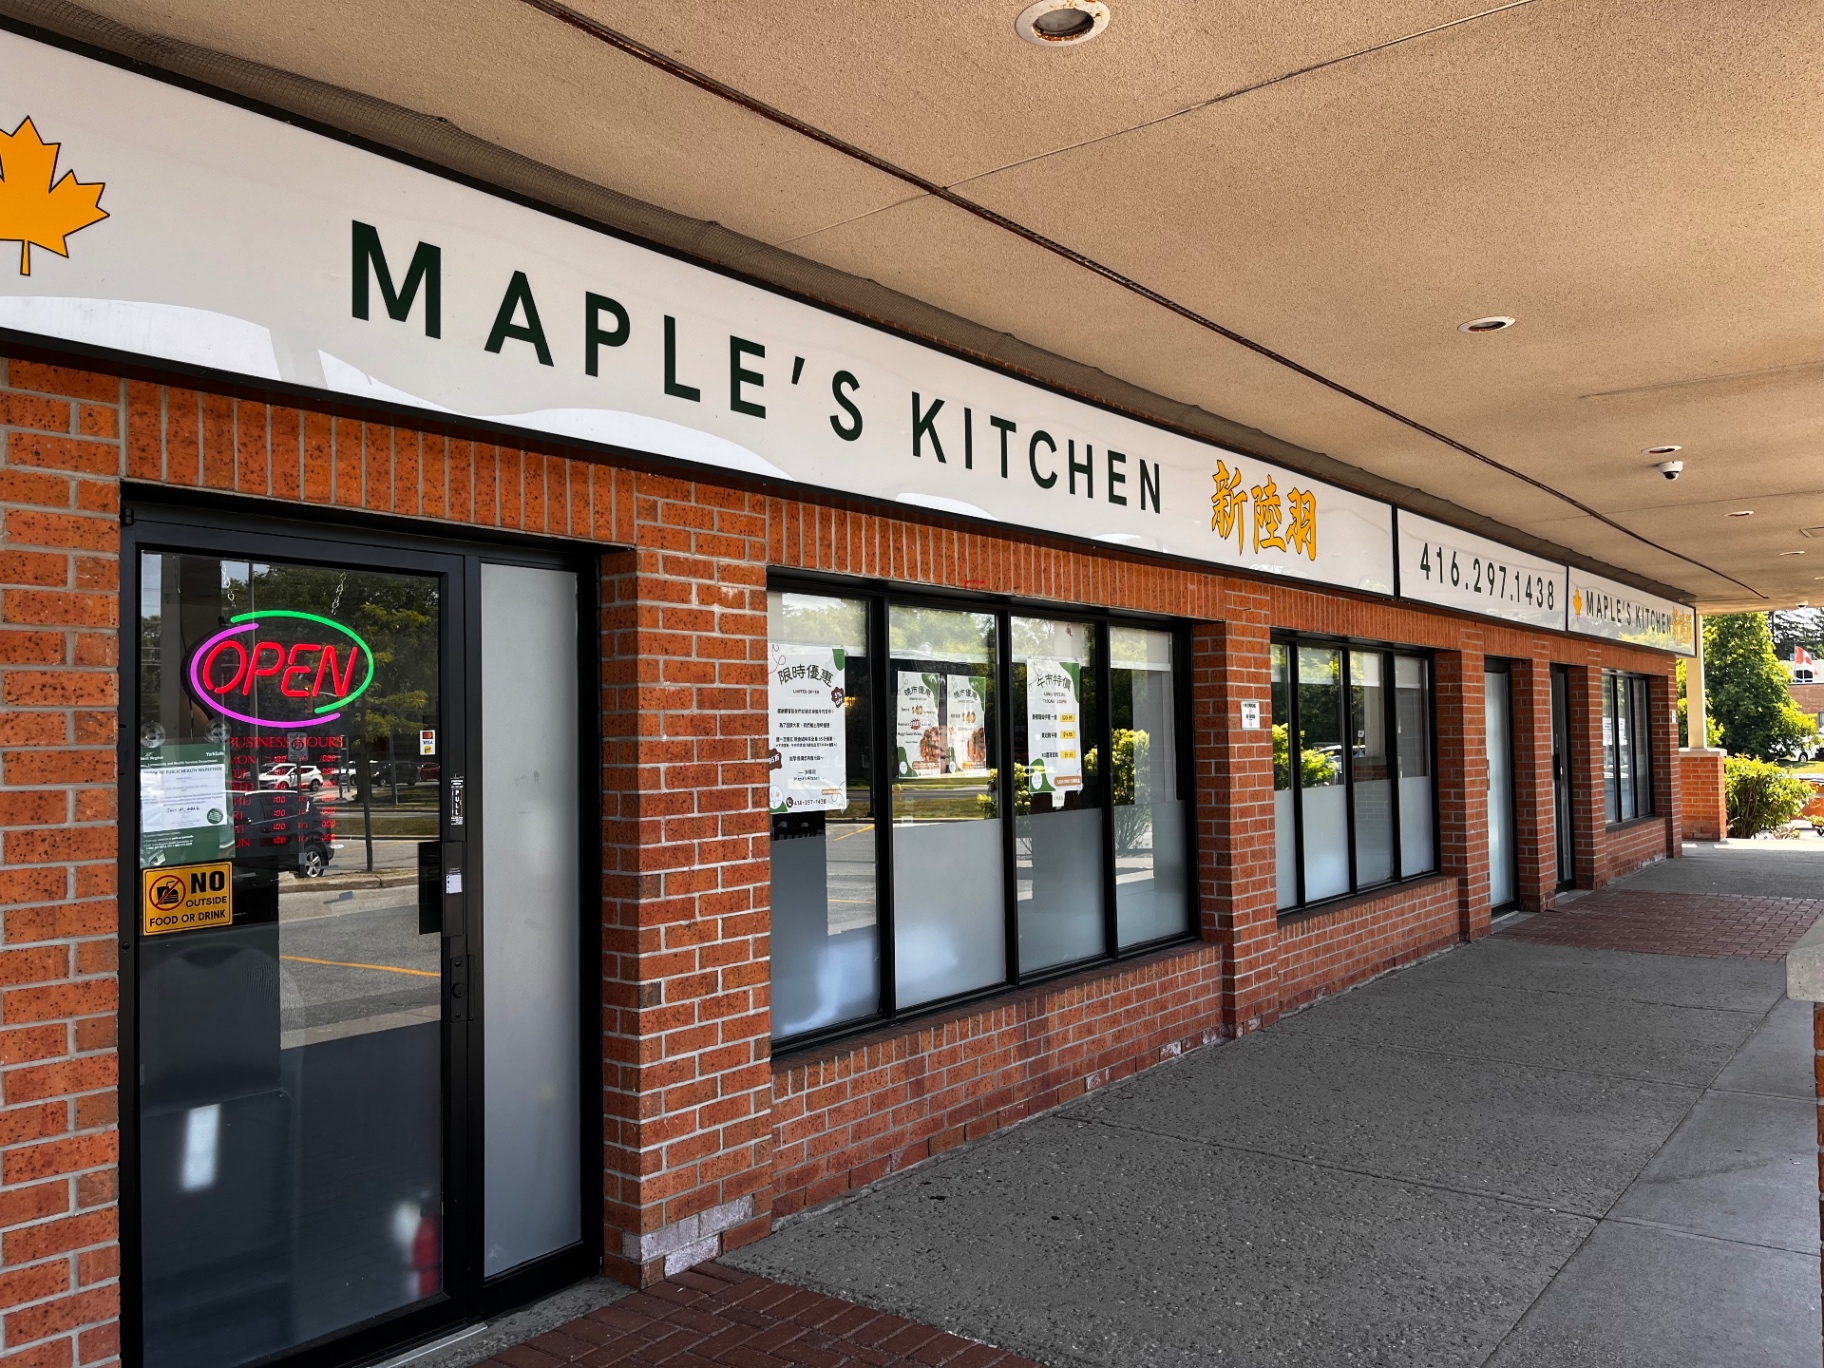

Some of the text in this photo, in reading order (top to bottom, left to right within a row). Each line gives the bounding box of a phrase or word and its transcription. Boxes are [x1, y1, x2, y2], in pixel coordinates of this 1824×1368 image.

[352, 219, 1161, 515] MAPLE'S KITCHEN
[1210, 459, 1317, 562] 新陸羽
[1420, 542, 1554, 611] 416.297.1438
[1586, 590, 1672, 636] MAPLE'S KITCHEN
[202, 639, 358, 698] OPEN
[778, 664, 833, 688] 限時優惠
[228, 736, 344, 749] BUSINESS HOURS
[190, 870, 225, 894] NO
[150, 909, 226, 927] FOOD OR DRINK
[185, 895, 228, 907] OUTSIDE
